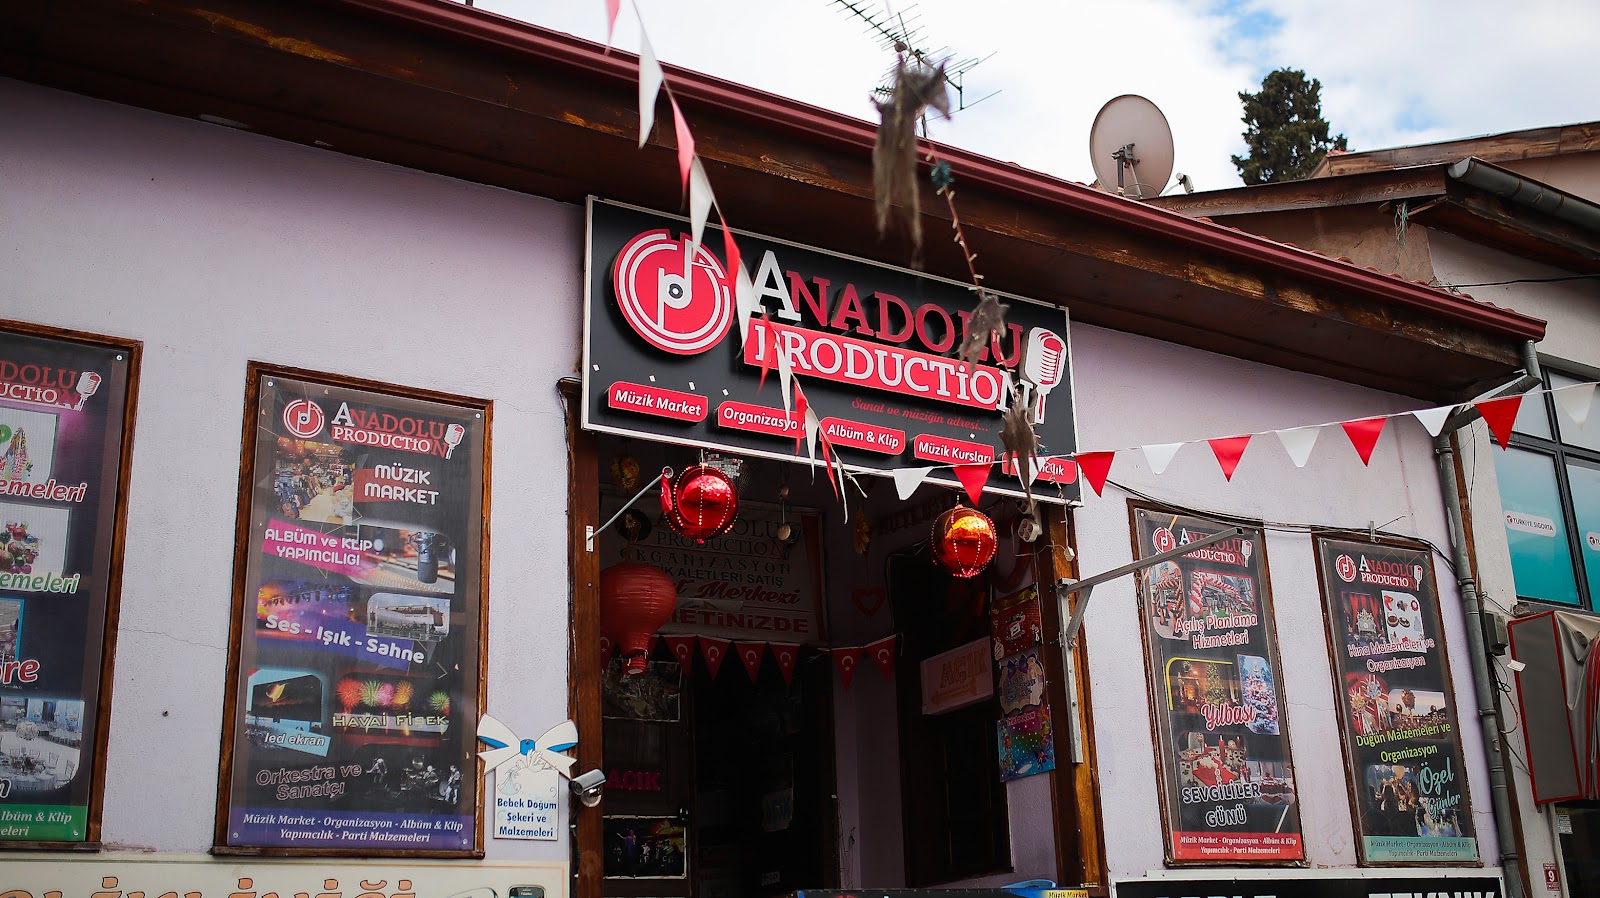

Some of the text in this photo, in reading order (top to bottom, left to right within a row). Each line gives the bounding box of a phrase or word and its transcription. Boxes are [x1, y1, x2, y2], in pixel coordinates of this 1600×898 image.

[614, 389, 702, 417] Müzik Market
[331, 402, 446, 440] ANADOLU
[886, 406, 901, 416] ve
[901, 409, 945, 425] müziğin
[827, 423, 900, 450] Albüm & Klip
[918, 441, 992, 464] Müzik Kursları
[364, 482, 440, 505] MARKET
[264, 528, 317, 546] ALBÜM
[320, 537, 338, 548] ve
[1358, 554, 1414, 578] ANADOLU
[0, 570, 80, 594] emeleri
[677, 565, 743, 583] ALETLERİ
[747, 574, 784, 589] SATIŞ
[692, 580, 800, 606] Merkezi
[1175, 612, 1258, 635] Açılış Planlama
[265, 614, 301, 635] Ses
[316, 626, 351, 646] Işık
[366, 638, 426, 664] Sahne
[1193, 629, 1250, 651] Hizmetleri
[1424, 637, 1435, 649] ve
[1366, 655, 1427, 673] Organizasyon
[1200, 703, 1257, 732] Yılbaşı
[264, 732, 326, 747] led ekran
[1386, 722, 1440, 742] Malzemeleri
[1440, 723, 1451, 733] ve
[1380, 744, 1438, 763] Organizasyon
[255, 763, 363, 786] Orkestra ve
[1419, 756, 1454, 796] Özel
[275, 781, 346, 801] Sanatçı
[497, 797, 557, 811] Bebek Doğum
[1428, 790, 1461, 819] Günler
[36, 811, 46, 822] &
[47, 811, 73, 825] Klip
[243, 813, 276, 825] Müzik
[278, 814, 316, 826] Market
[323, 816, 393, 829] Organizasyon
[400, 819, 432, 830] Albüm
[434, 820, 443, 830] &
[443, 820, 464, 833] Klip
[507, 811, 547, 824] Şekeri ve
[1205, 803, 1248, 828] GÜNÜ
[280, 828, 334, 842] Yapımcılık
[342, 830, 368, 841] Parti
[369, 831, 431, 843] Malzemeleri
[499, 825, 554, 838] Malzemeleri
[1180, 836, 1198, 844] Müzik
[1221, 836, 1260, 846] Organizasyon
[1262, 837, 1280, 845] Albüm
[1285, 837, 1297, 847] Klip
[1233, 846, 1247, 854] Parti
[1248, 846, 1280, 855] Malzemeleri
[1548, 870, 1555, 882] 9
